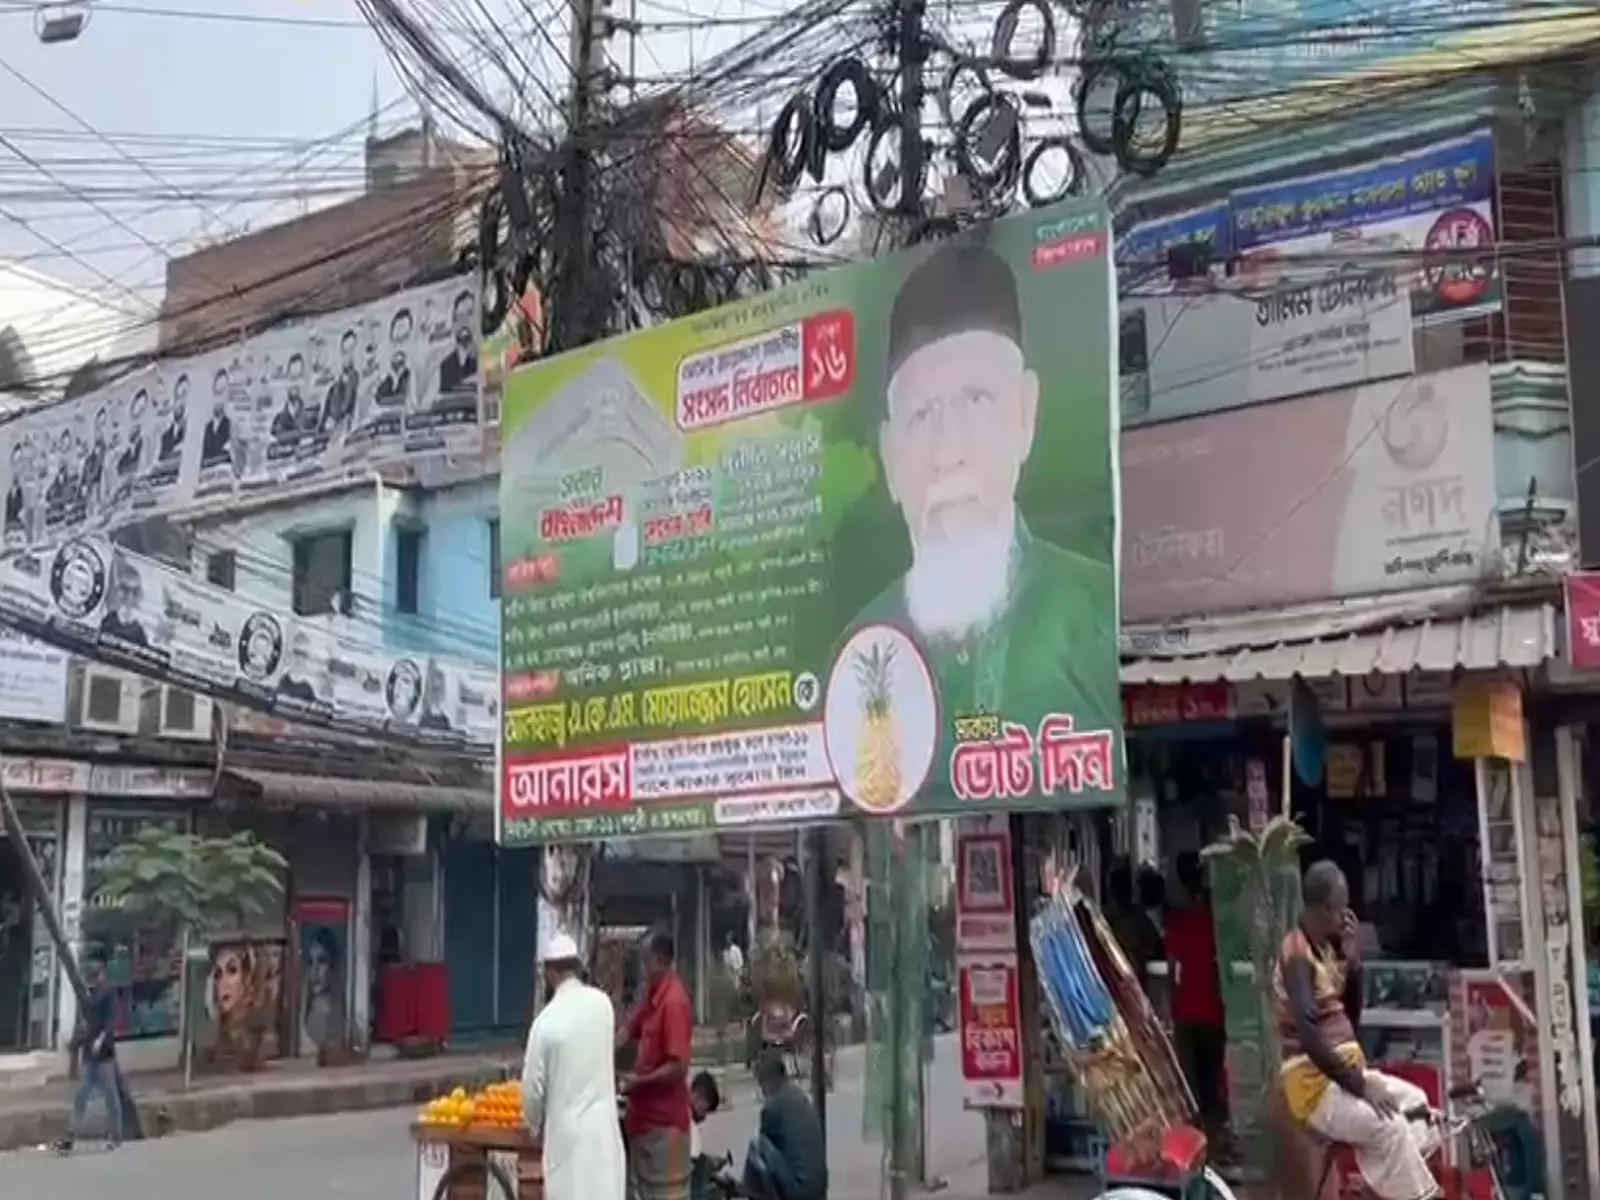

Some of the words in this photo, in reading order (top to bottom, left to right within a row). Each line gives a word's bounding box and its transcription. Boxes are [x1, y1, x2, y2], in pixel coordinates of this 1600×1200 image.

[683, 384, 730, 424] সংসদ
[733, 361, 801, 412] নির্বাচনে
[807, 343, 848, 389] ১৬
[732, 671, 792, 717] হোসেন
[508, 753, 627, 808] আনারস
[951, 722, 1033, 799] ভোট
[1037, 714, 1114, 796] দিন
